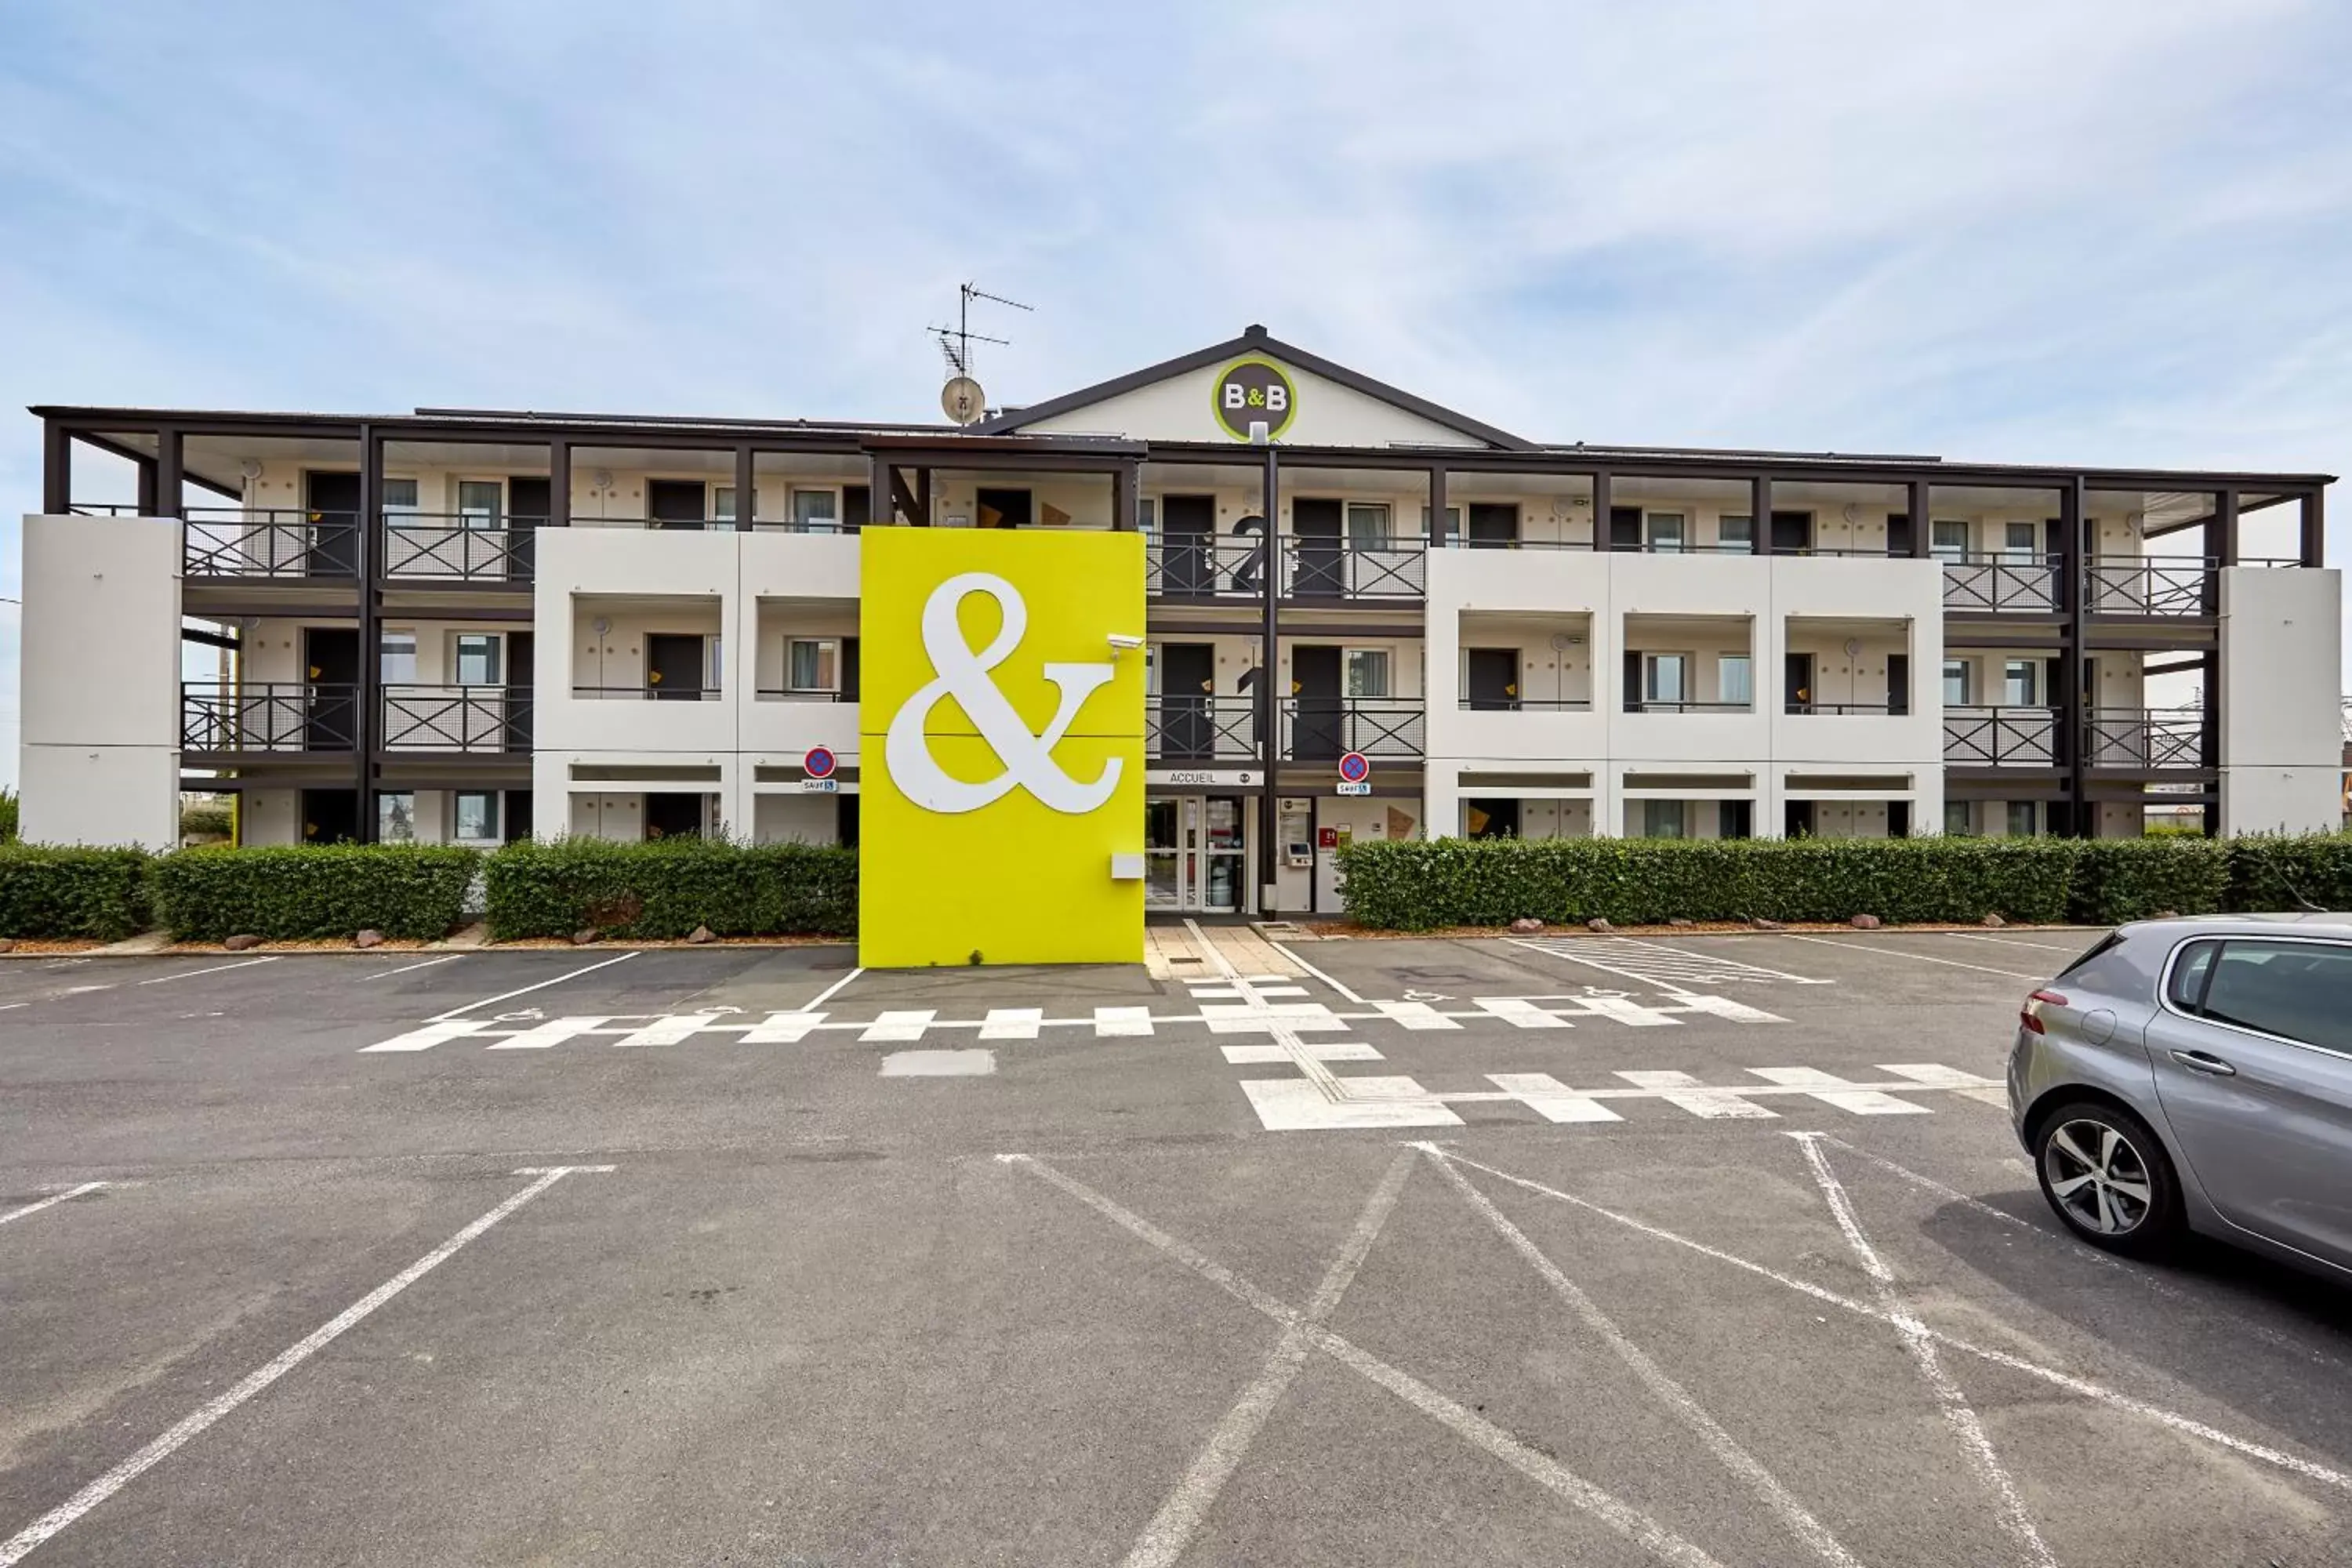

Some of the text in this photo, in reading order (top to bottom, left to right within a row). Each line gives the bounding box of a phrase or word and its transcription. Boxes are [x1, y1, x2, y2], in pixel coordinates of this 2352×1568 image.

[1225, 383, 1287, 411] B&B
[885, 571, 1123, 813] &
[1171, 772, 1216, 782] ACCUEIL
